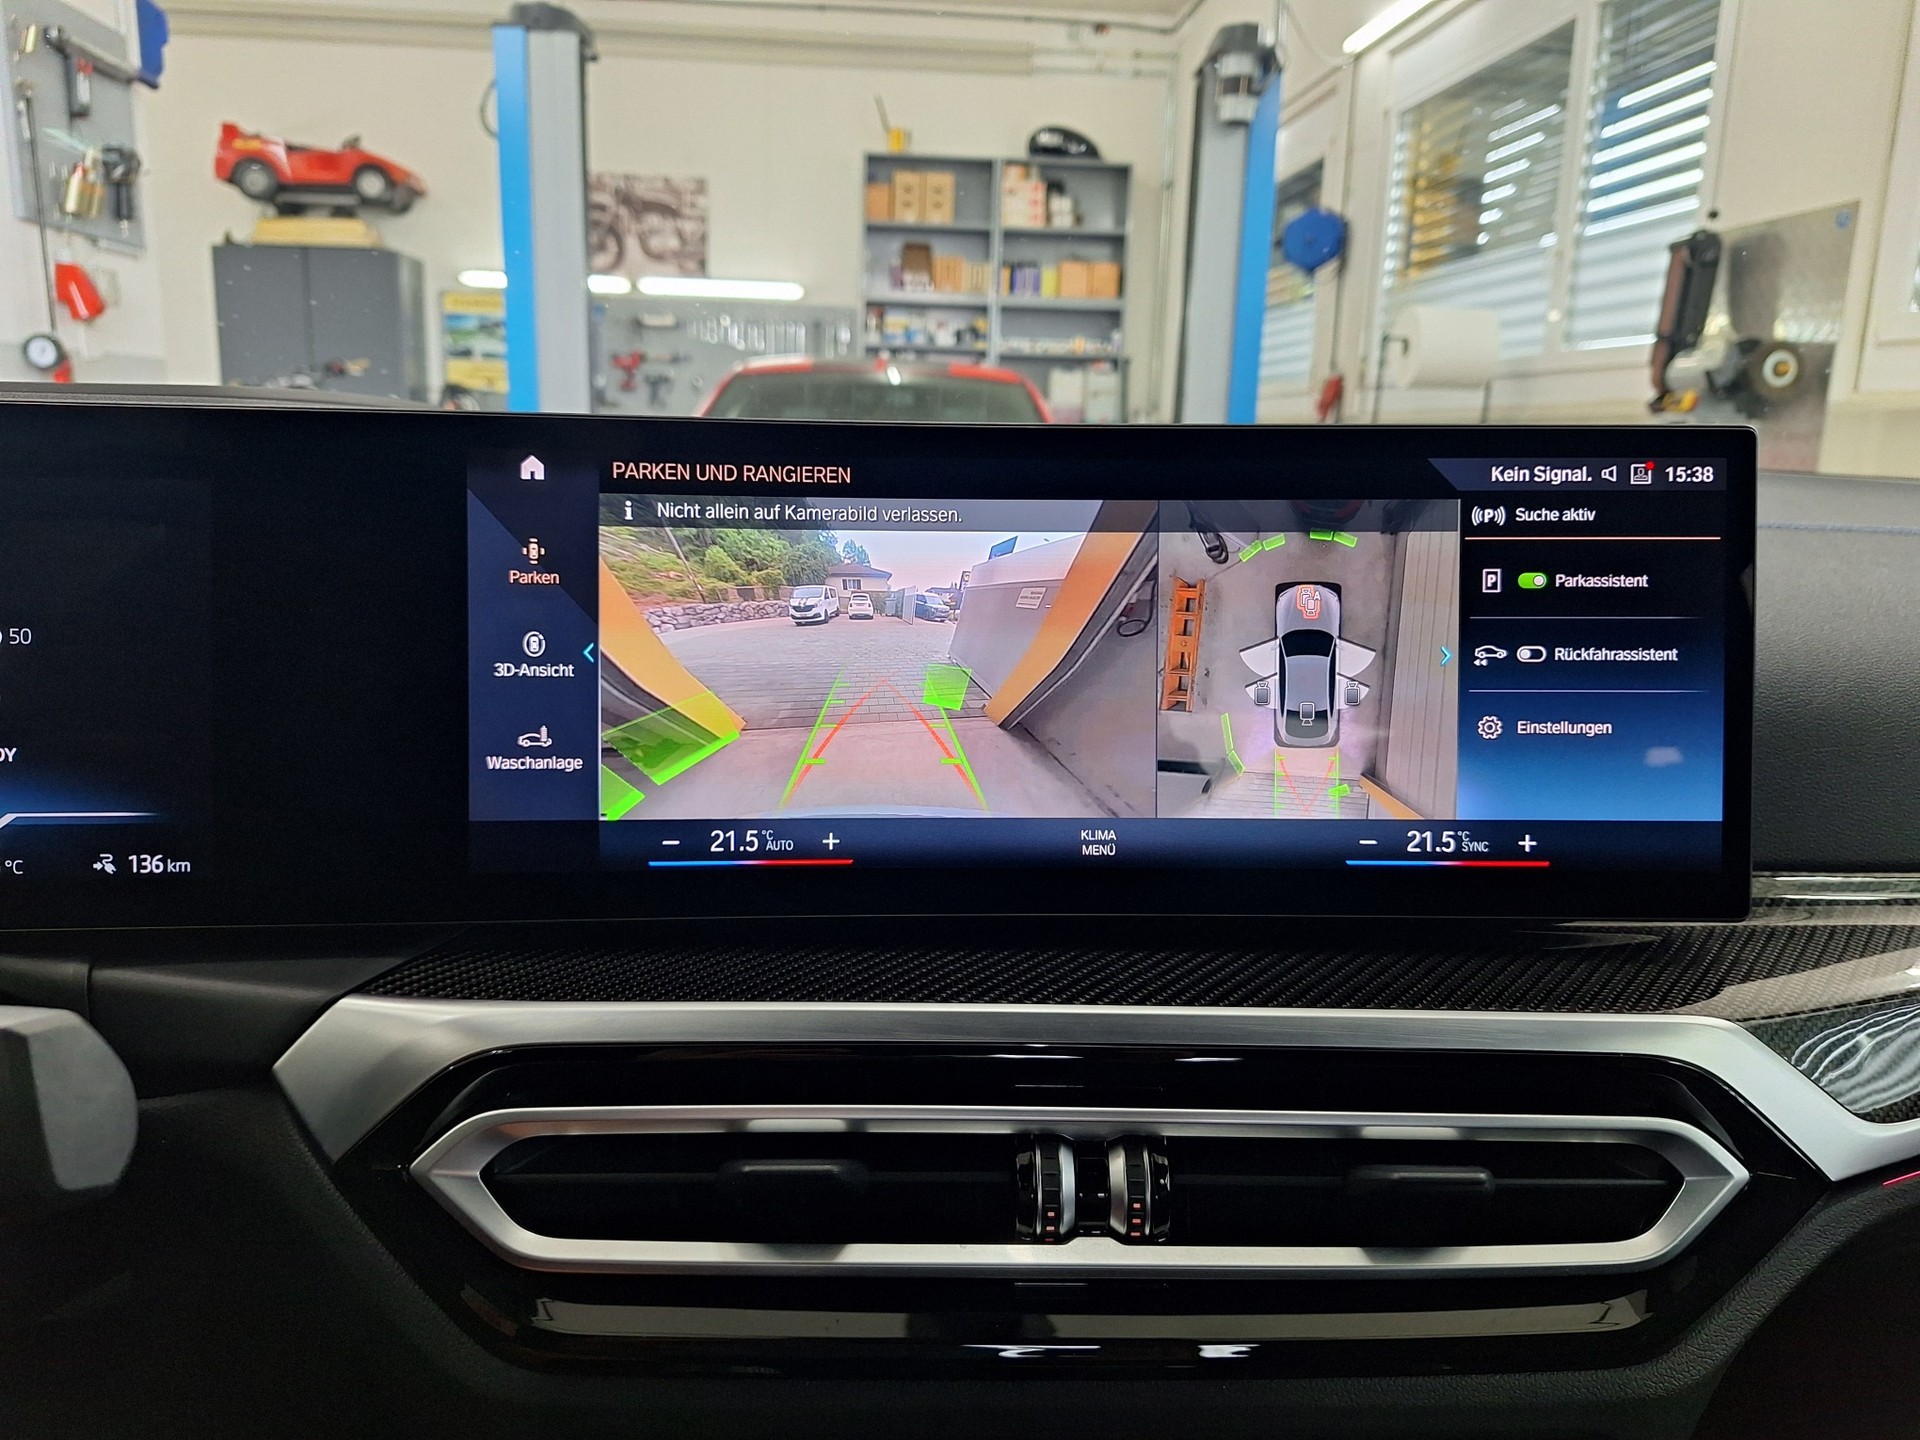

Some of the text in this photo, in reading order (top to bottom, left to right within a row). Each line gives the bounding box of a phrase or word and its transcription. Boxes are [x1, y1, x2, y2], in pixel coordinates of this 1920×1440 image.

[612, 462, 851, 484] PARKEN UND RANGIEREN
[1491, 466, 1592, 485] Kein Signal.
[1665, 467, 1714, 483] 15:38
[657, 502, 963, 523] Nicht allein auf Kamerabild verlassen.
[1515, 508, 1596, 522] Suche aktiv
[509, 570, 560, 585] Parken
[1555, 574, 1649, 588] Parkassistent
[9, 628, 32, 645] 50
[1554, 648, 1679, 662] Rückfahrassistent
[493, 662, 575, 678] 3D-Ansicht
[1517, 721, 1613, 737] Einstellungen
[486, 755, 584, 773] Waschanlage
[710, 829, 760, 852] 21.5
[1081, 829, 1117, 841] KLIMA
[1407, 830, 1456, 853] 21.5
[766, 839, 794, 851] AUTO
[1082, 842, 1116, 856] MENÜ
[1461, 841, 1489, 852] SYNC
[4, 860, 24, 874] °C
[128, 855, 191, 874] 136 km
